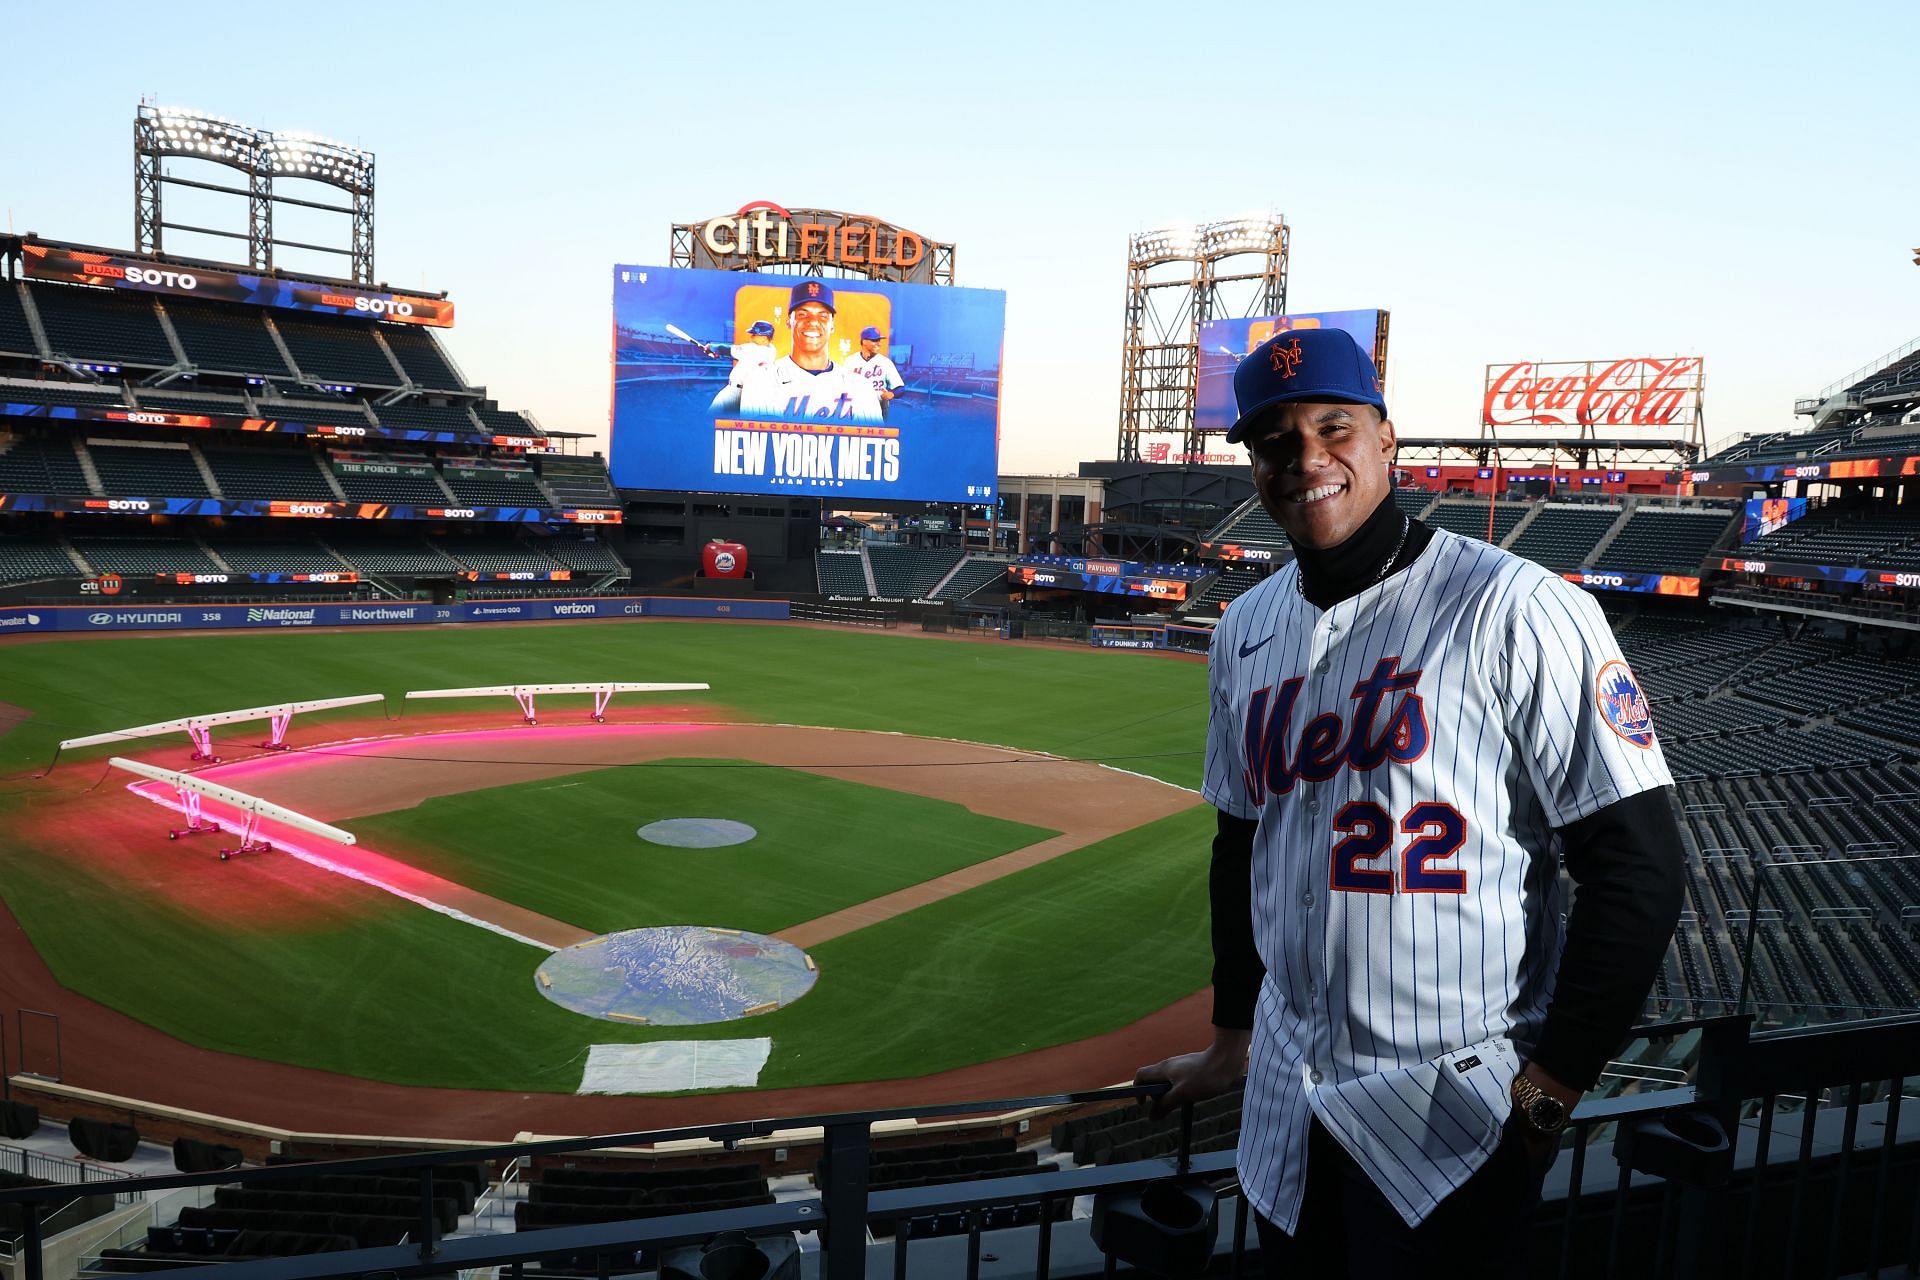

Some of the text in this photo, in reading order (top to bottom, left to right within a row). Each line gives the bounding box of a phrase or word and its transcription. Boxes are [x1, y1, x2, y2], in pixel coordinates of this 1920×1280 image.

[704, 211, 923, 266] citi FIELD
[85, 266, 197, 289] JUAN SOTO
[323, 296, 413, 316] JUAN SOTO
[784, 393, 854, 420] Mets
[127, 412, 166, 424] SOTO
[335, 427, 366, 437] SOTO
[734, 421, 814, 432] WELCOME
[857, 427, 886, 436] THE
[507, 438, 533, 446] SOTO
[714, 430, 900, 482] NEW YORK METS
[1194, 451, 1236, 463] balance
[342, 464, 361, 473] THE
[364, 465, 398, 474] PORCH
[1796, 466, 1820, 476] SOTO
[1692, 472, 1710, 481] SOTO
[108, 500, 150, 510] SOTO
[289, 505, 325, 514] SOTO
[444, 509, 475, 518] SOTO
[577, 512, 604, 521] SOTO
[1243, 550, 1272, 559] SOTO
[1087, 564, 1118, 573] PAVILION
[1744, 562, 1766, 573] SOTO
[195, 575, 228, 583] SOTO
[309, 573, 339, 582] SOTO
[1034, 574, 1055, 583] SOTO
[1583, 574, 1623, 586] SOTO
[80, 582, 99, 590] citi
[1143, 585, 1167, 593] SOTO
[554, 603, 596, 615] verizon
[624, 602, 642, 614] citi
[117, 613, 182, 623] HYUNDAI
[202, 613, 221, 621] 358
[263, 609, 315, 620] National
[353, 608, 415, 620] Northwell
[436, 610, 450, 618] 370
[1245, 656, 1430, 808] Mets
[1330, 801, 1468, 895] 22
